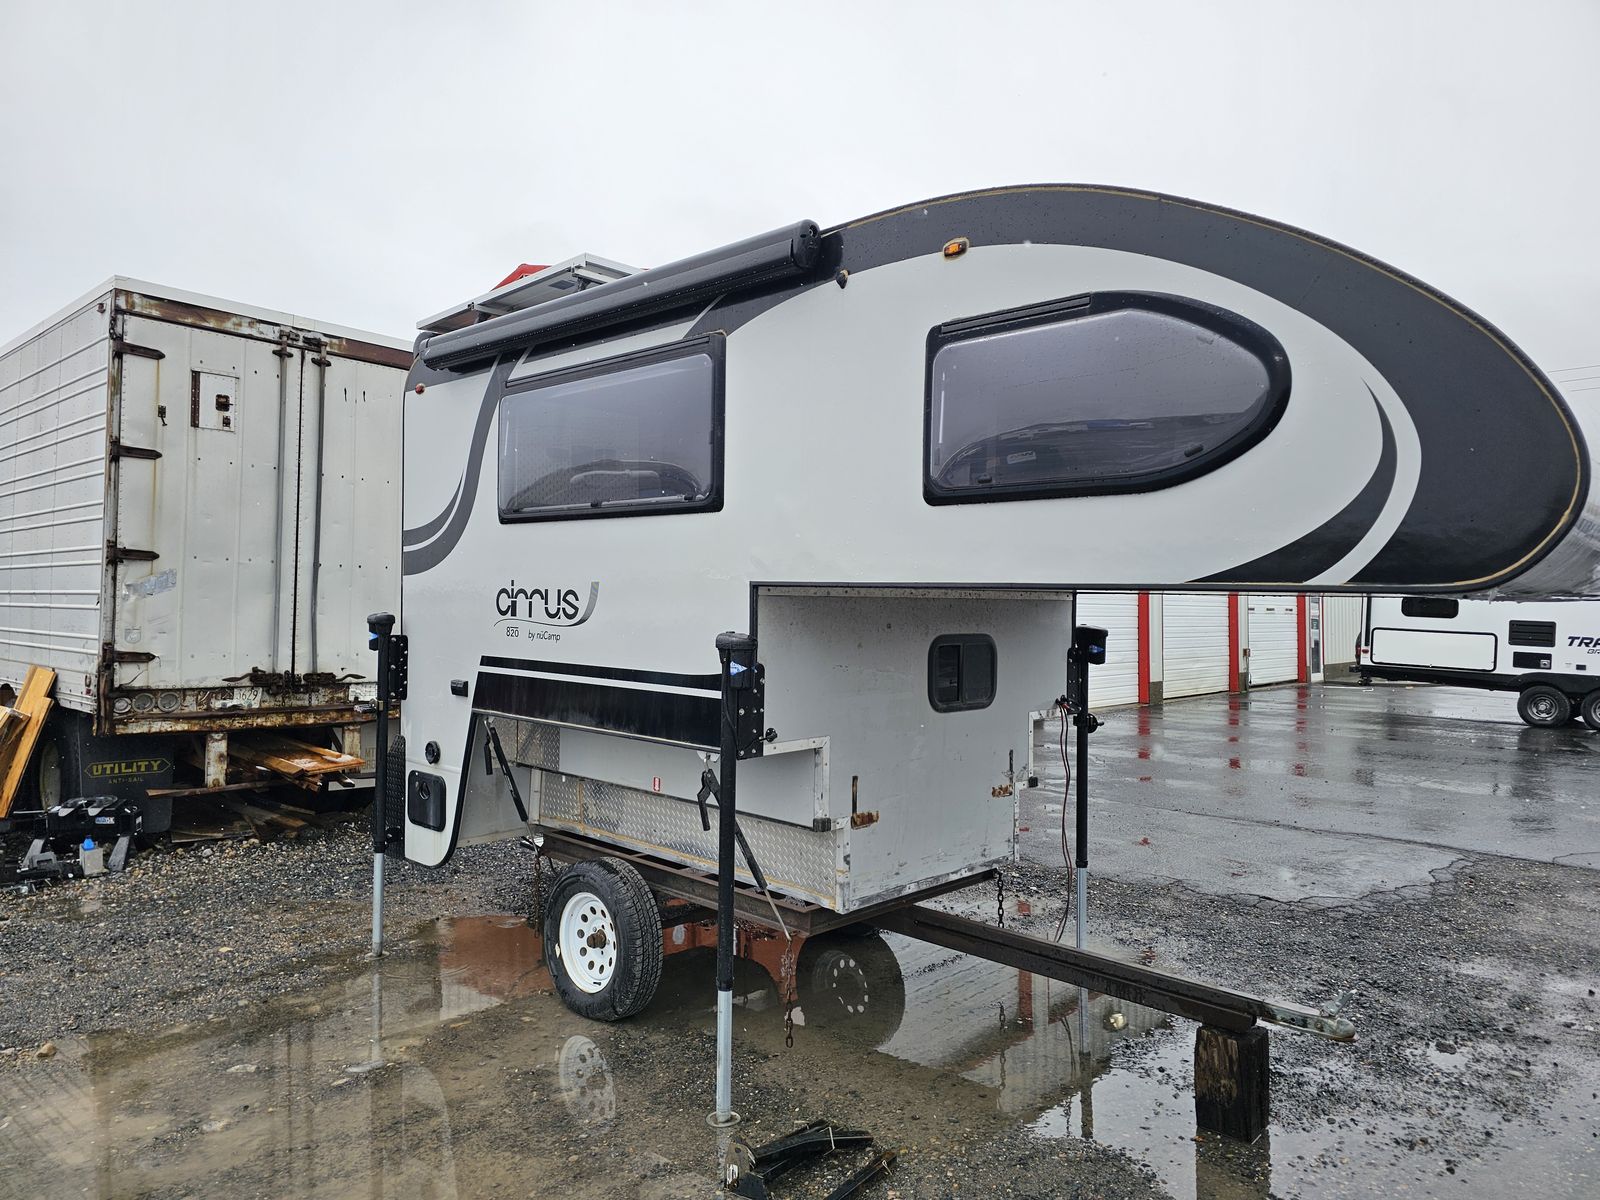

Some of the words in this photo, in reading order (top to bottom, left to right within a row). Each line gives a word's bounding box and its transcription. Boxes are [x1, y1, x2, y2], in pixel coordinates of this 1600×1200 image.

[496, 580, 580, 620] cirrus
[506, 626, 519, 637] 820
[528, 629, 536, 641] by
[92, 760, 161, 776] UTILITY
